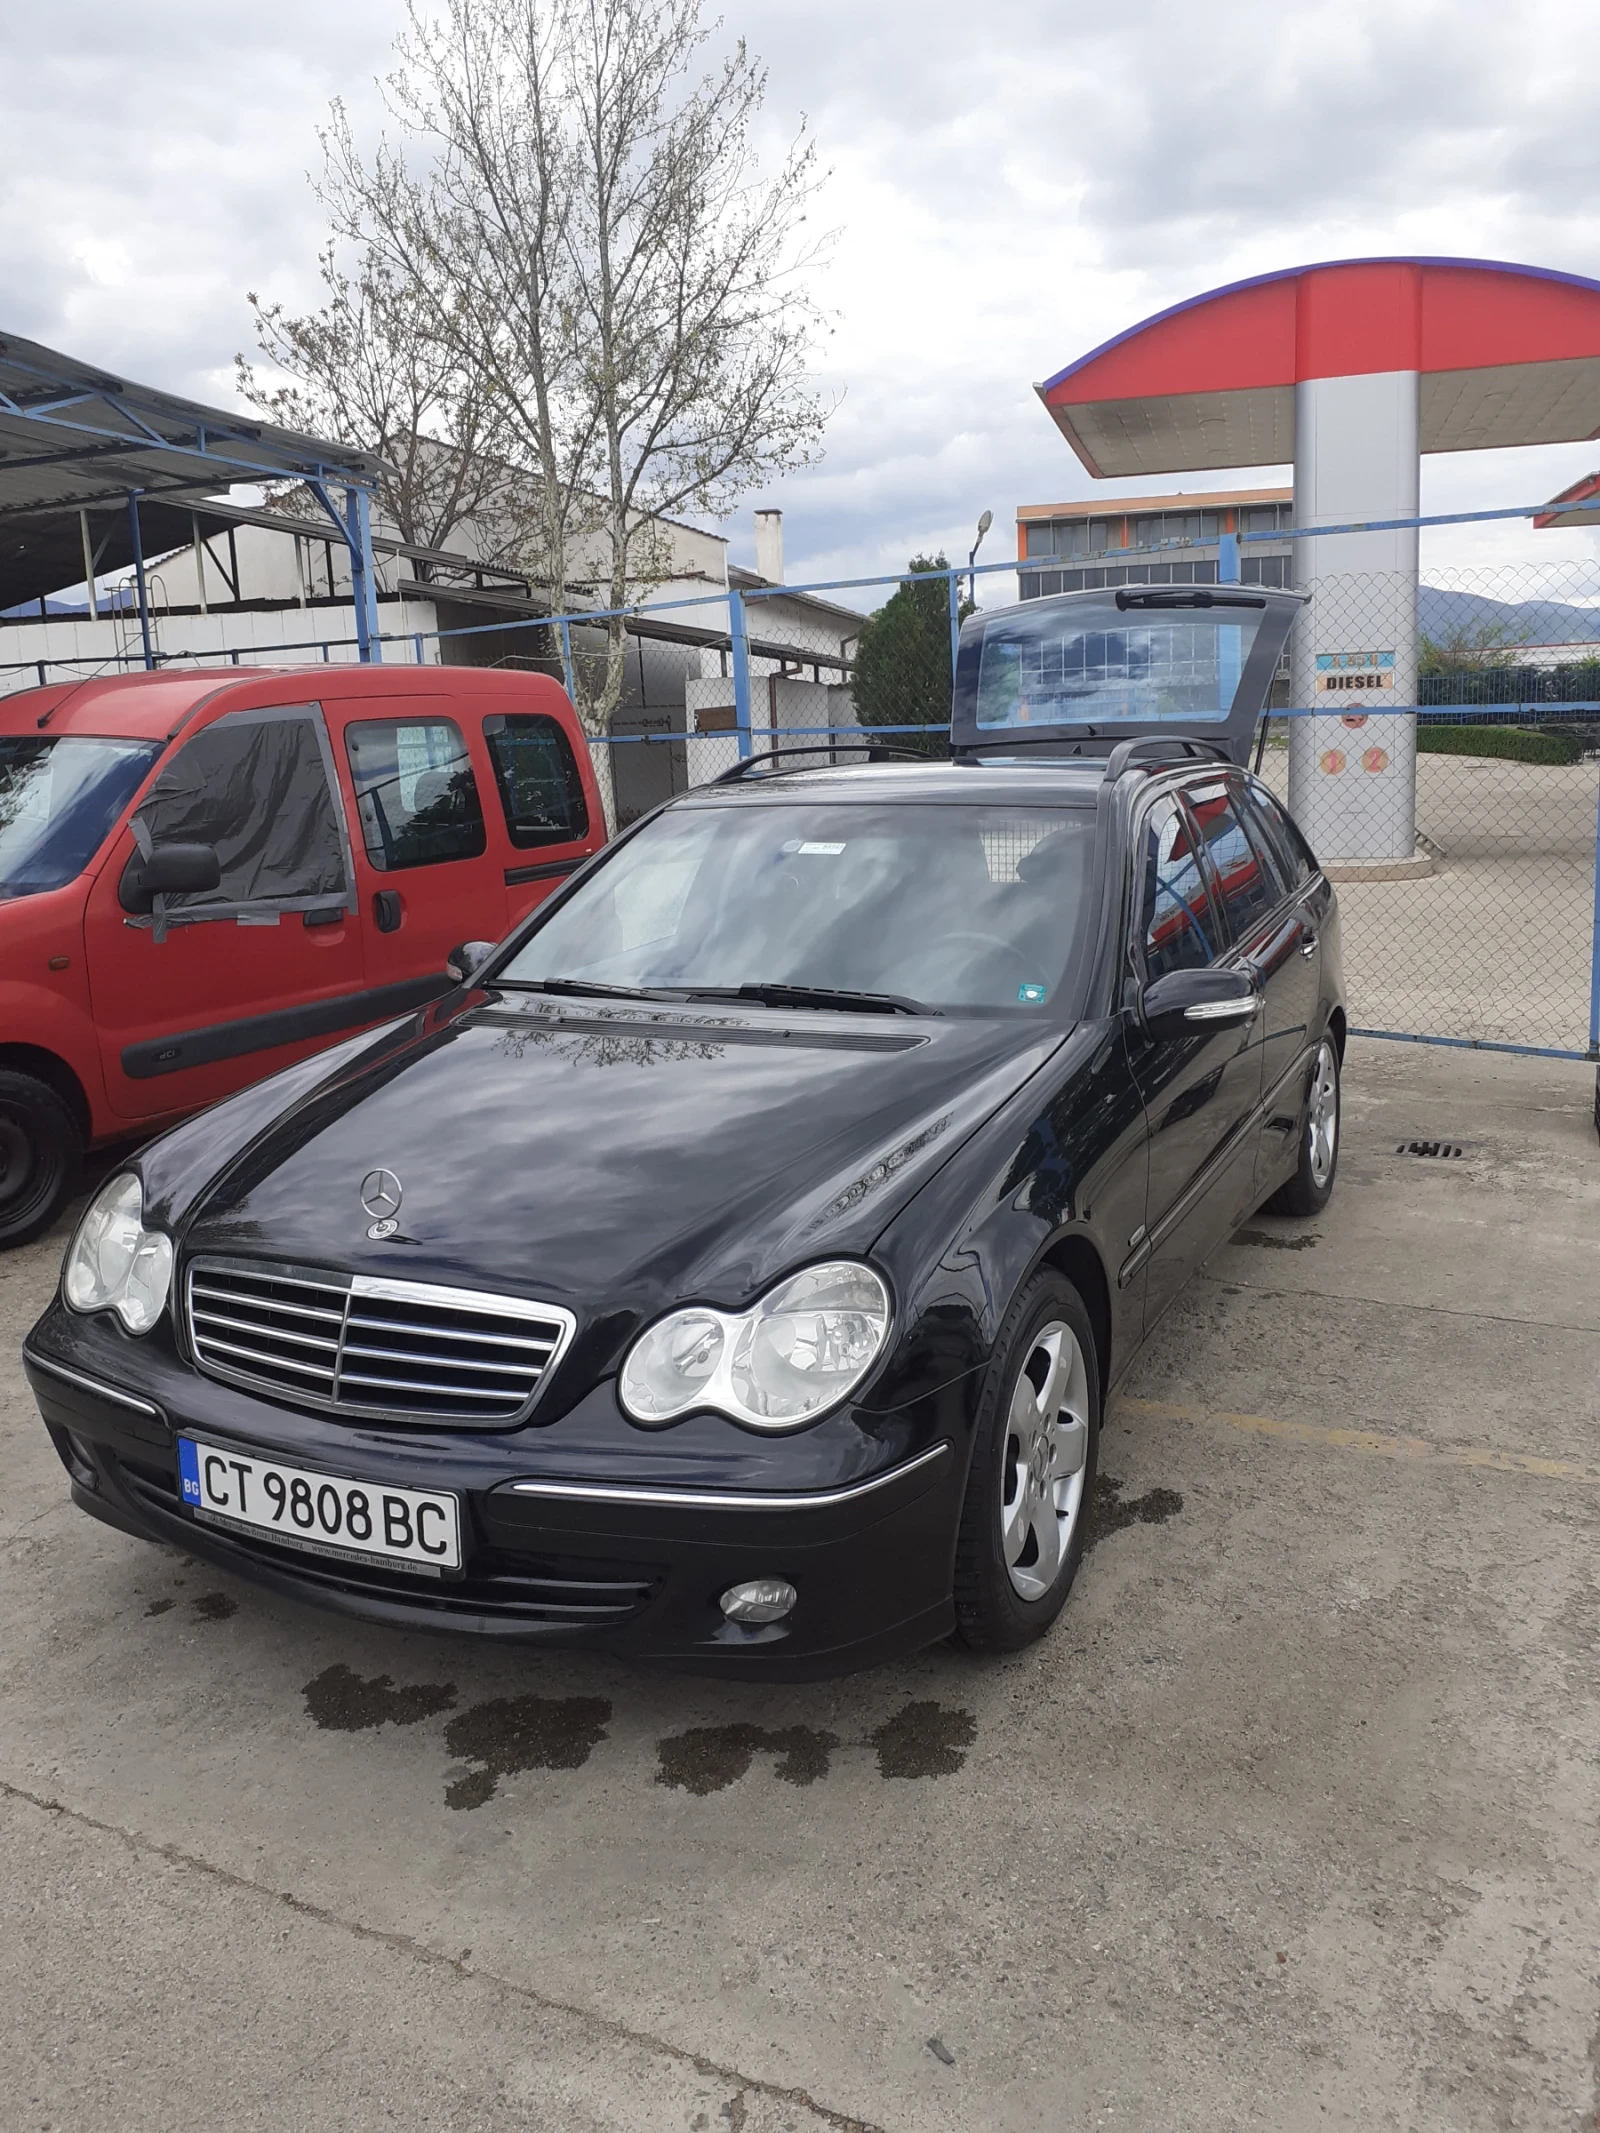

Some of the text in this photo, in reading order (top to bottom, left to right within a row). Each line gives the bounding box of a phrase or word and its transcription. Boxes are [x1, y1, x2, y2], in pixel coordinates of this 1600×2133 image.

[1326, 675, 1384, 690] DIESEL
[1328, 751, 1338, 774] 1
[1368, 748, 1381, 773] 2
[183, 1455, 448, 1556] BG CT 9808 BC
[271, 1533, 304, 1551] Hamburg
[311, 1544, 418, 1573] www.mercedes-hamburg.de
